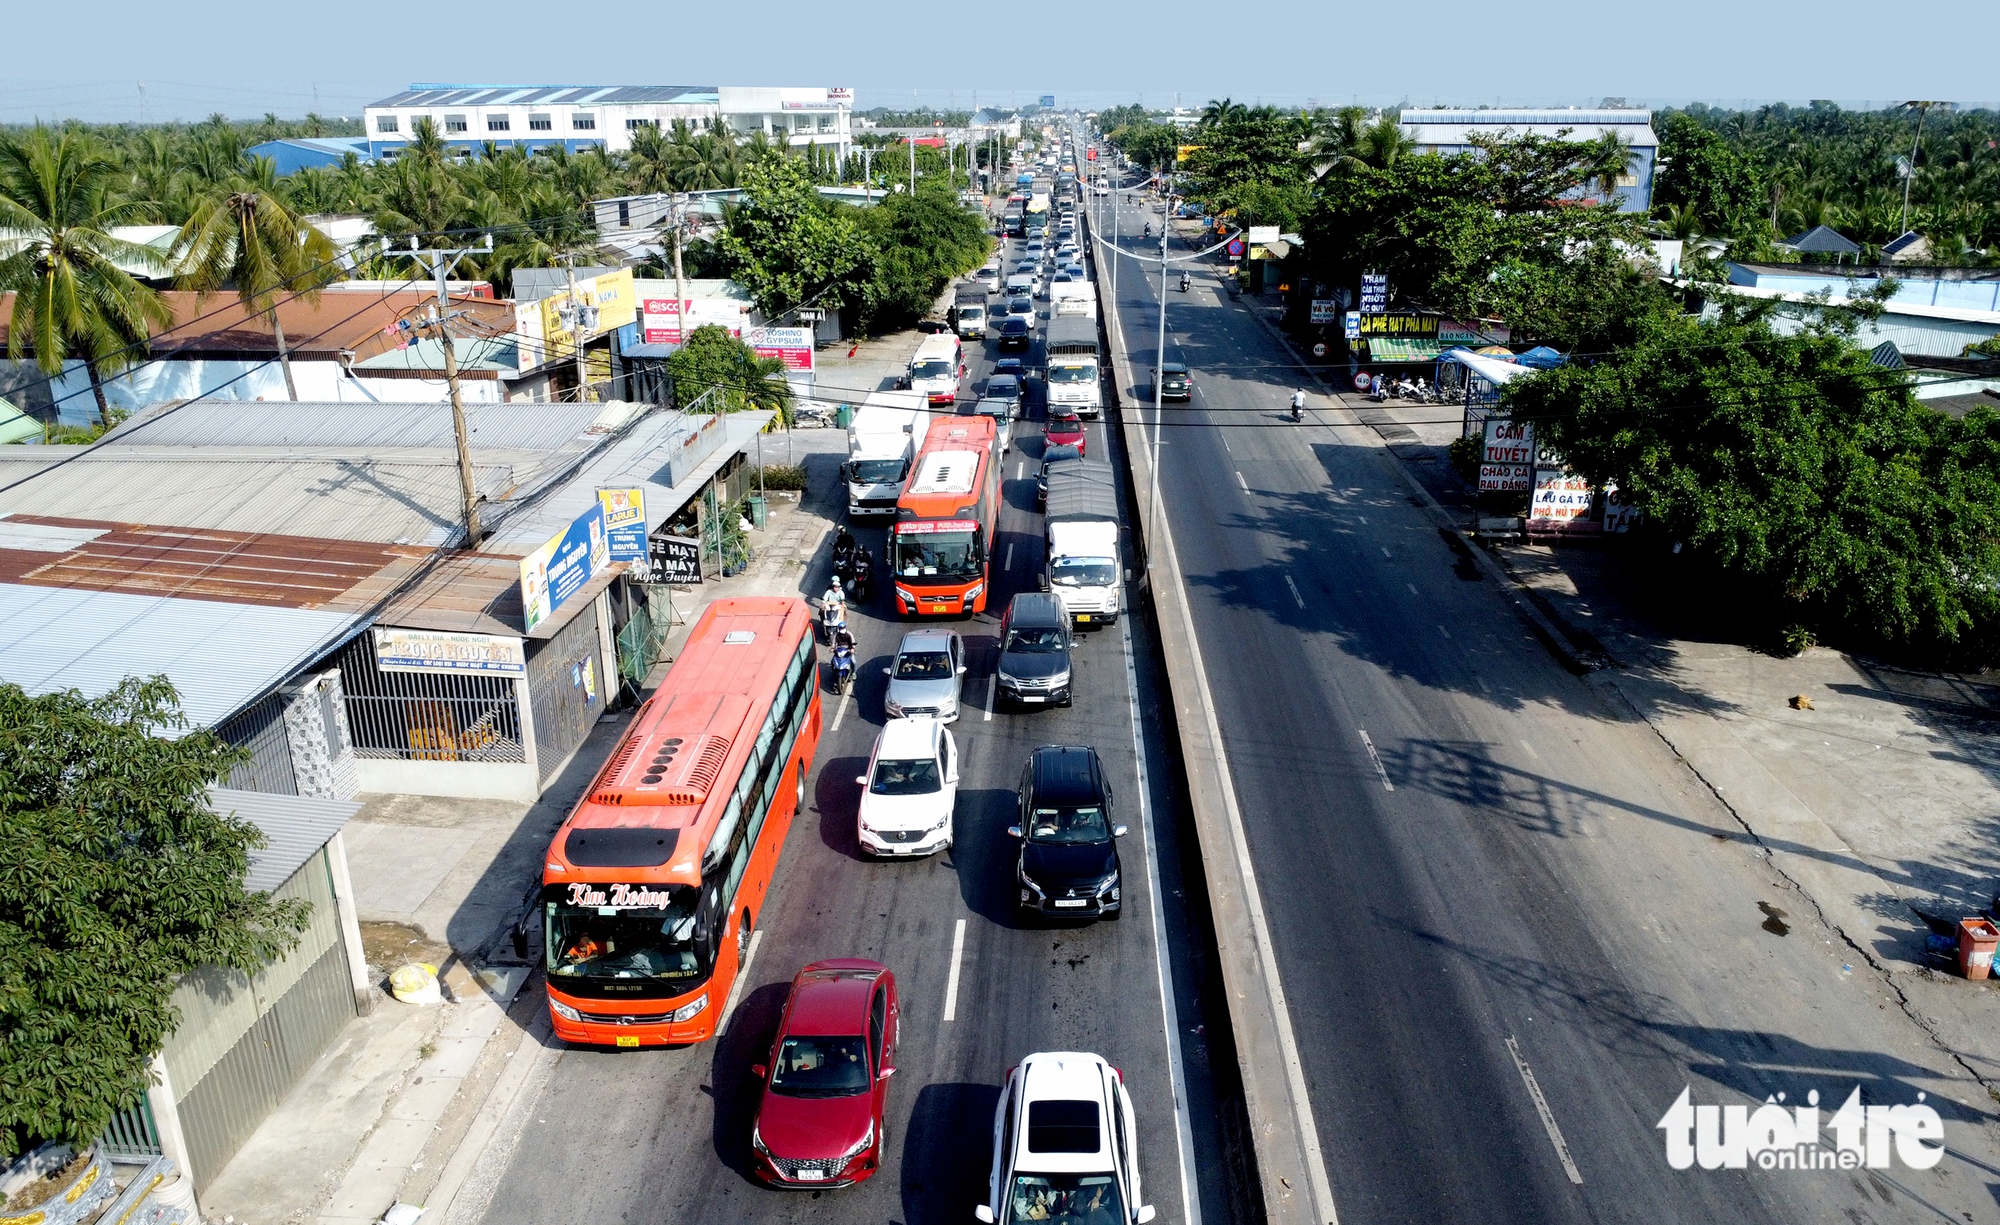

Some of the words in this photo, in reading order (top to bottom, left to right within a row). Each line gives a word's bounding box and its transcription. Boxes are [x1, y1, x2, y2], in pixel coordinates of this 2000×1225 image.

[1362, 294, 1386, 302] NHỚT
[800, 312, 815, 320] NAM
[1361, 313, 1371, 332] CÀ
[1372, 314, 1388, 332] PHÊ
[1389, 316, 1404, 336] HẠT
[1405, 316, 1420, 332] PHA
[766, 329, 802, 337] YOSHINO
[1486, 442, 1529, 462] TUYẾT
[1481, 464, 1510, 477] CHÁO
[1514, 465, 1528, 477] CÁ
[1480, 480, 1499, 490] RAU
[1502, 476, 1528, 490] ĐẮNG
[1559, 493, 1573, 504] GÀ
[607, 510, 636, 522] LARUE
[613, 534, 636, 542] TRUNG
[669, 544, 696, 558] HẠT
[548, 559, 567, 584] TRUNG
[566, 542, 588, 568] NGUYÊN
[472, 636, 490, 644] NGỌT
[393, 642, 444, 659] TRUNG
[446, 642, 513, 662] NGUYÊN
[566, 882, 607, 906] Kim
[610, 883, 671, 910] Hoàng
